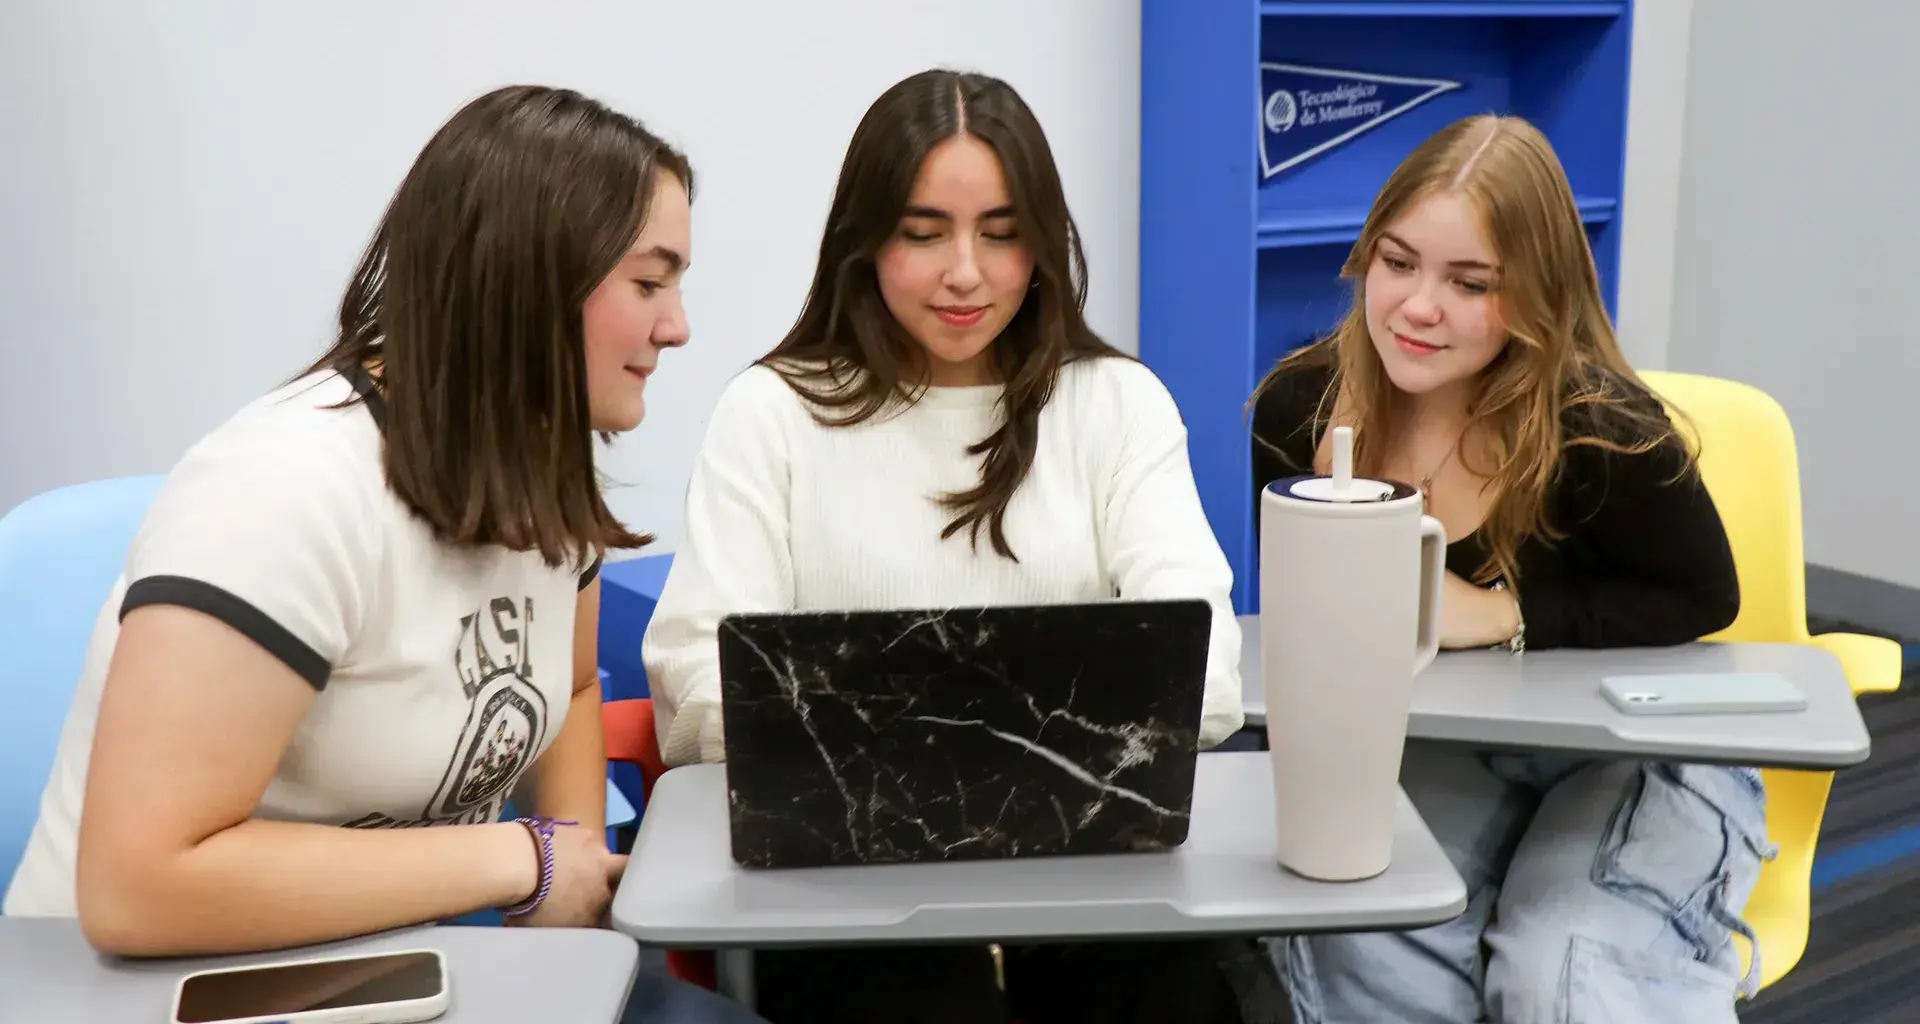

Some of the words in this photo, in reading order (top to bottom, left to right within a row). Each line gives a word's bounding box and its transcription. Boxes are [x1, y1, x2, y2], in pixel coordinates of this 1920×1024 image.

[1298, 83, 1378, 107] Tecnológico
[1300, 109, 1317, 127] de
[1319, 100, 1384, 123] Monterrey
